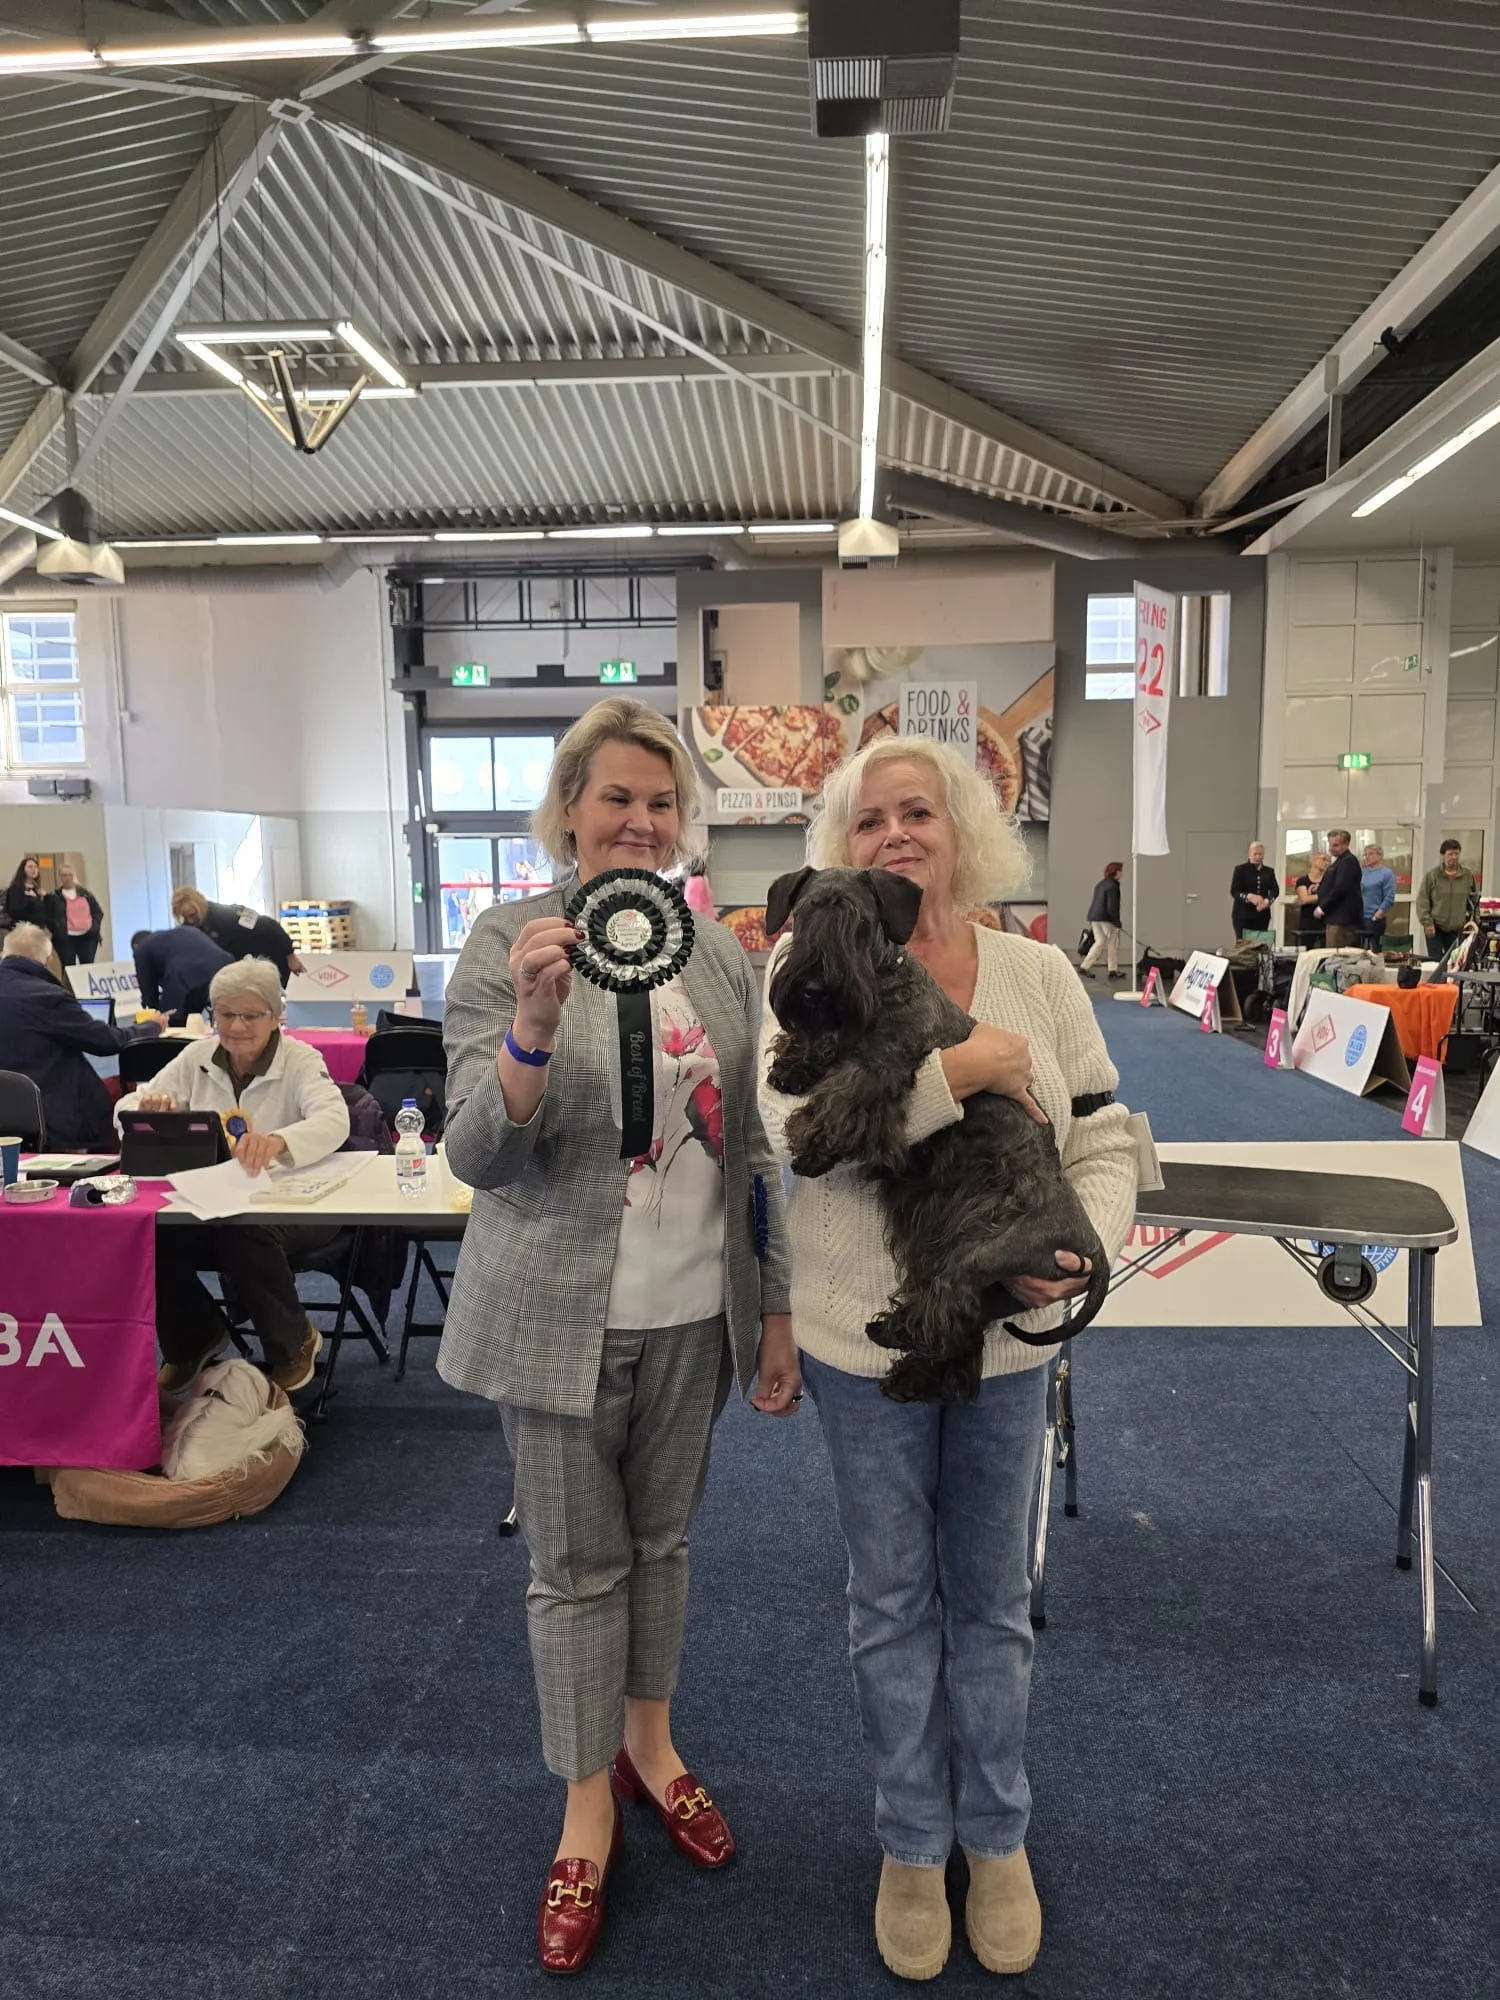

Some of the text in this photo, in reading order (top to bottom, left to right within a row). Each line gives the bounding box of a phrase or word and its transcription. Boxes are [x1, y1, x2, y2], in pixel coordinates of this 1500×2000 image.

[1139, 599, 1167, 631] RING
[1138, 638, 1165, 697] 22
[907, 689, 970, 717] FOOD &
[906, 716, 970, 744] DRINKS
[721, 791, 798, 809] PIZZA & PINSA
[88, 968, 130, 998] Agria
[1268, 1028, 1280, 1058] 3
[627, 1030, 648, 1122] Best of Breed
[1410, 1084, 1428, 1122] 4
